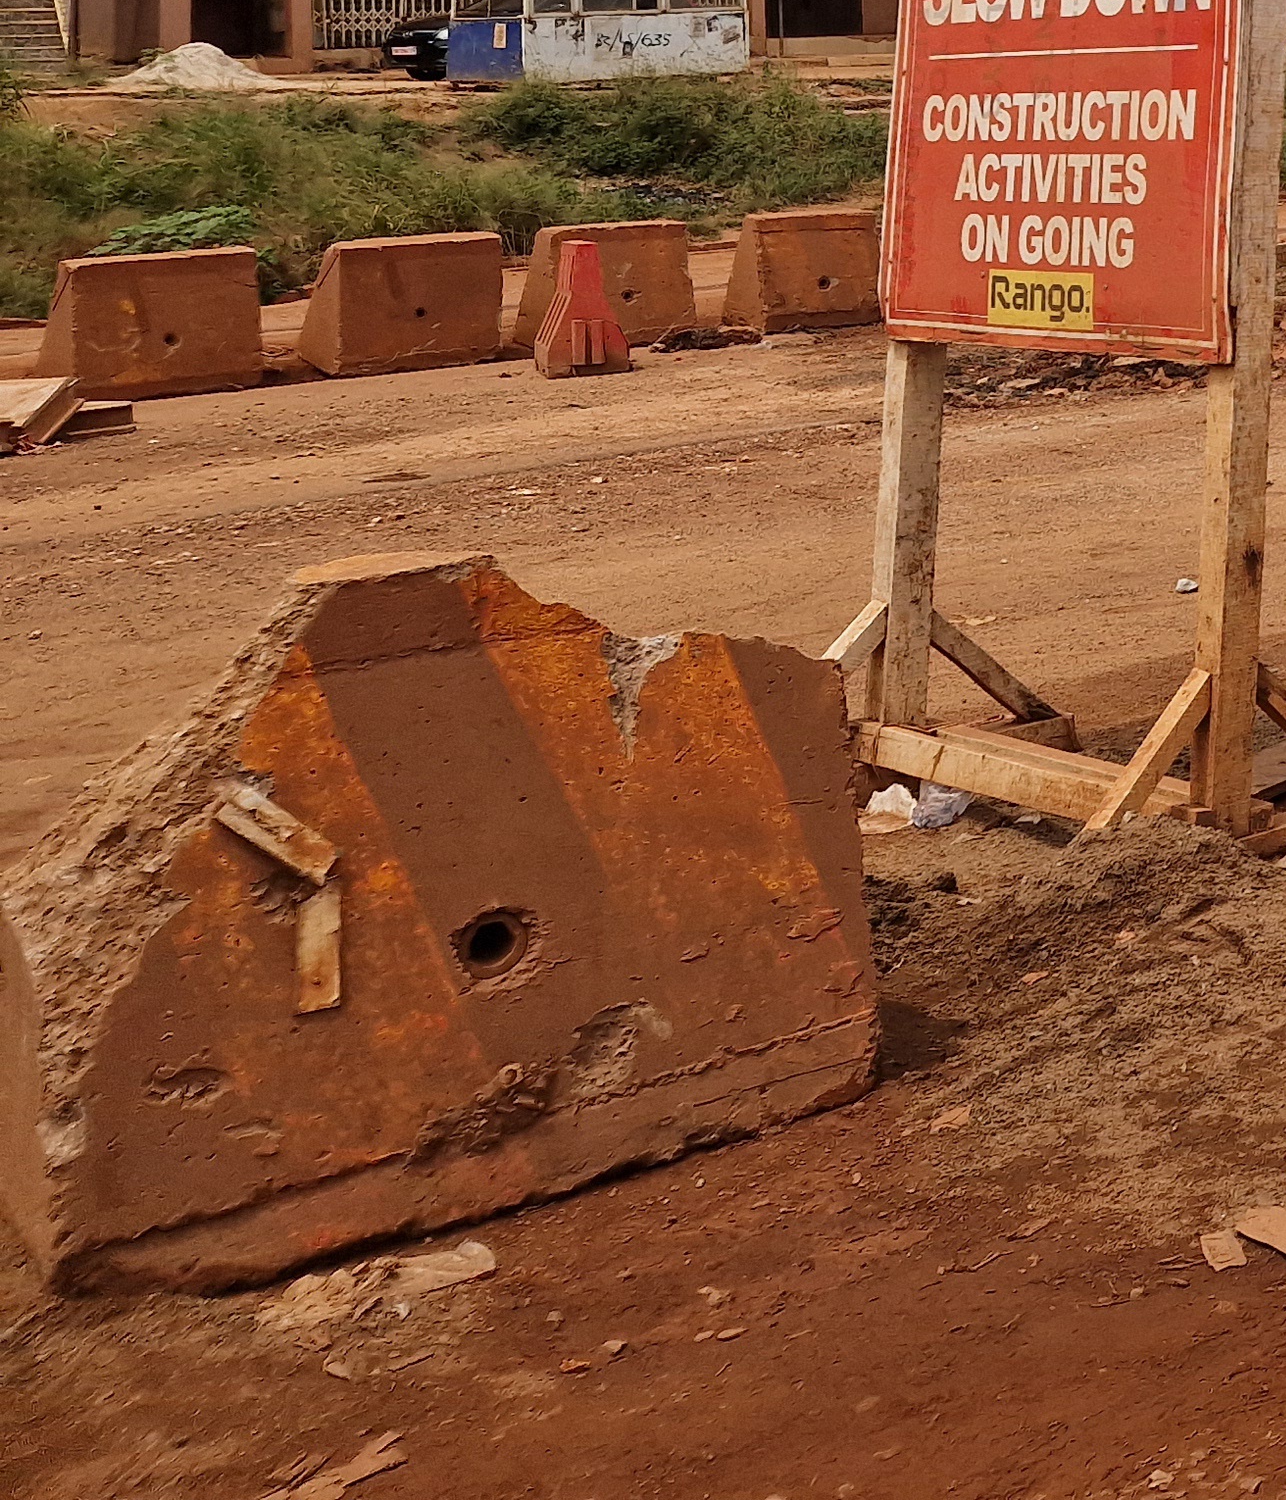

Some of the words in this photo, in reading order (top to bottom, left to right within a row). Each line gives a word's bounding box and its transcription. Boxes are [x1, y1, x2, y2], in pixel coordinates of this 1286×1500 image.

[922, 89, 1197, 142] CONSTRUCTION
[954, 153, 1147, 205] ACTIVITIES
[961, 214, 1009, 263] ON
[1018, 214, 1134, 269] GOING
